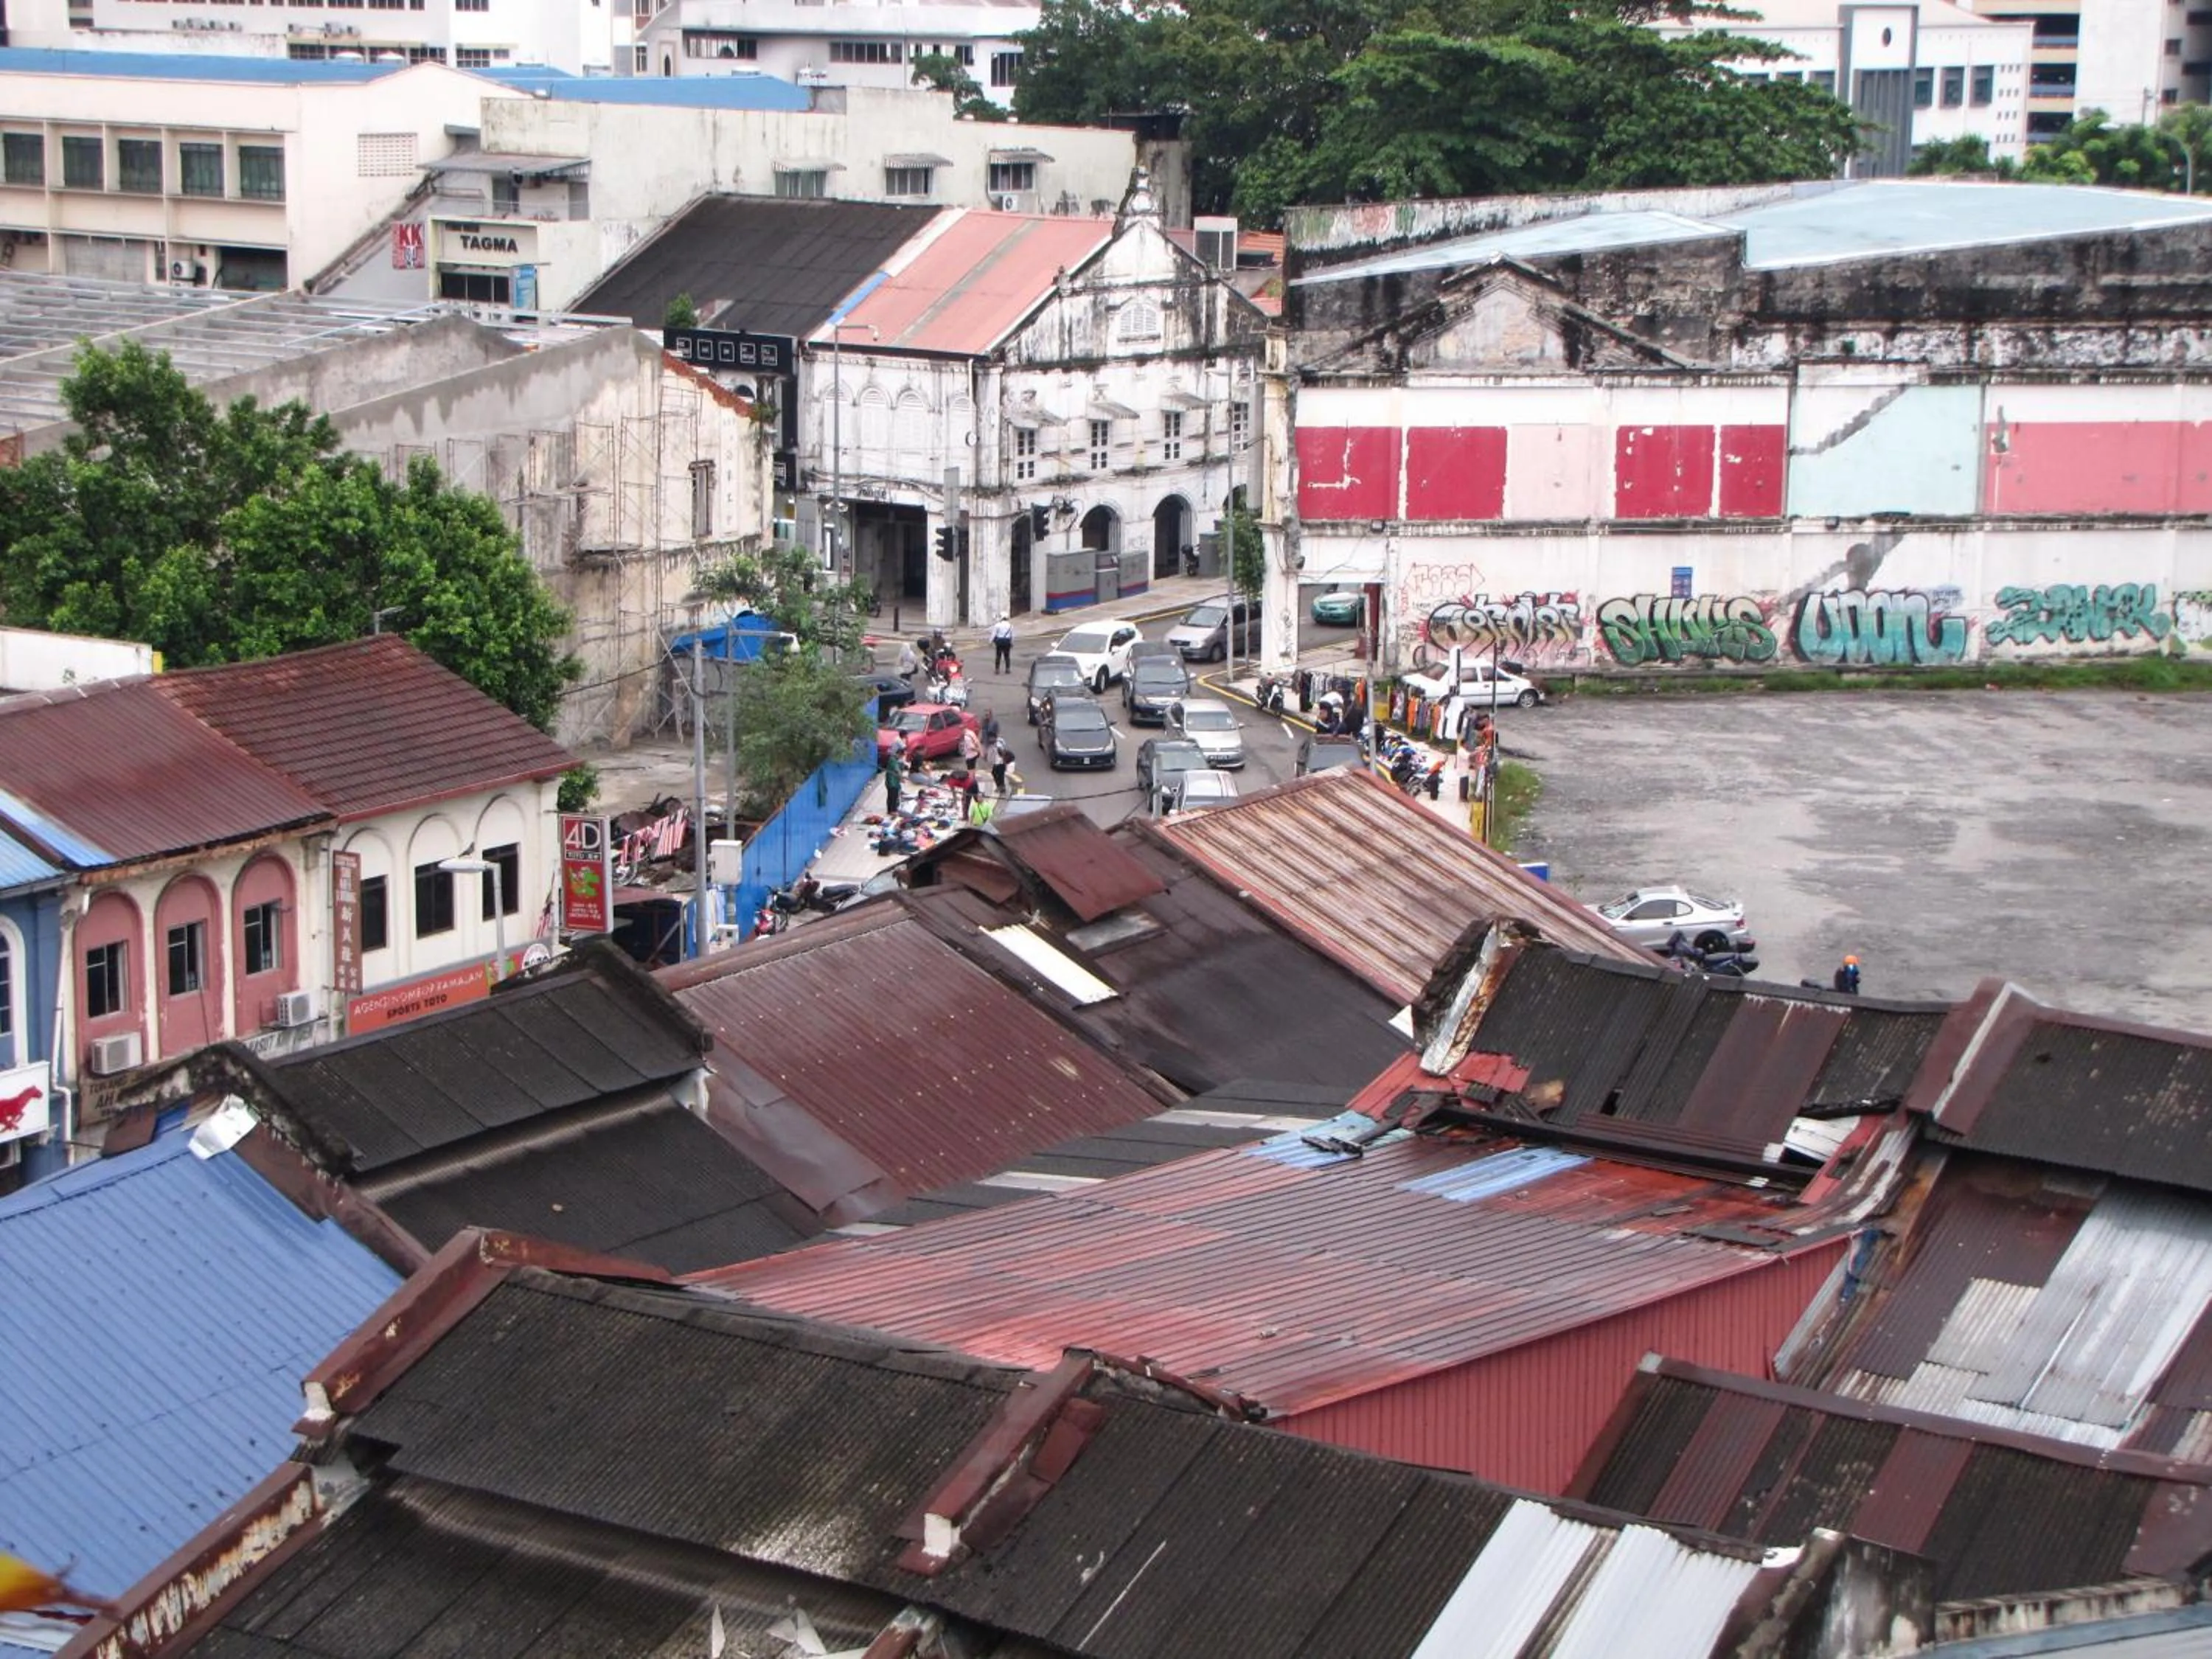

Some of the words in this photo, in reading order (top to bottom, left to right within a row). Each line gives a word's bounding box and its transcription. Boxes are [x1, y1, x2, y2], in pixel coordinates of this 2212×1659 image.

[399, 223, 422, 246] KK
[460, 234, 518, 254] TAGMA
[565, 822, 601, 849] 4D
[386, 1001, 421, 1020] SPORTS
[424, 993, 448, 1008] TOTO
